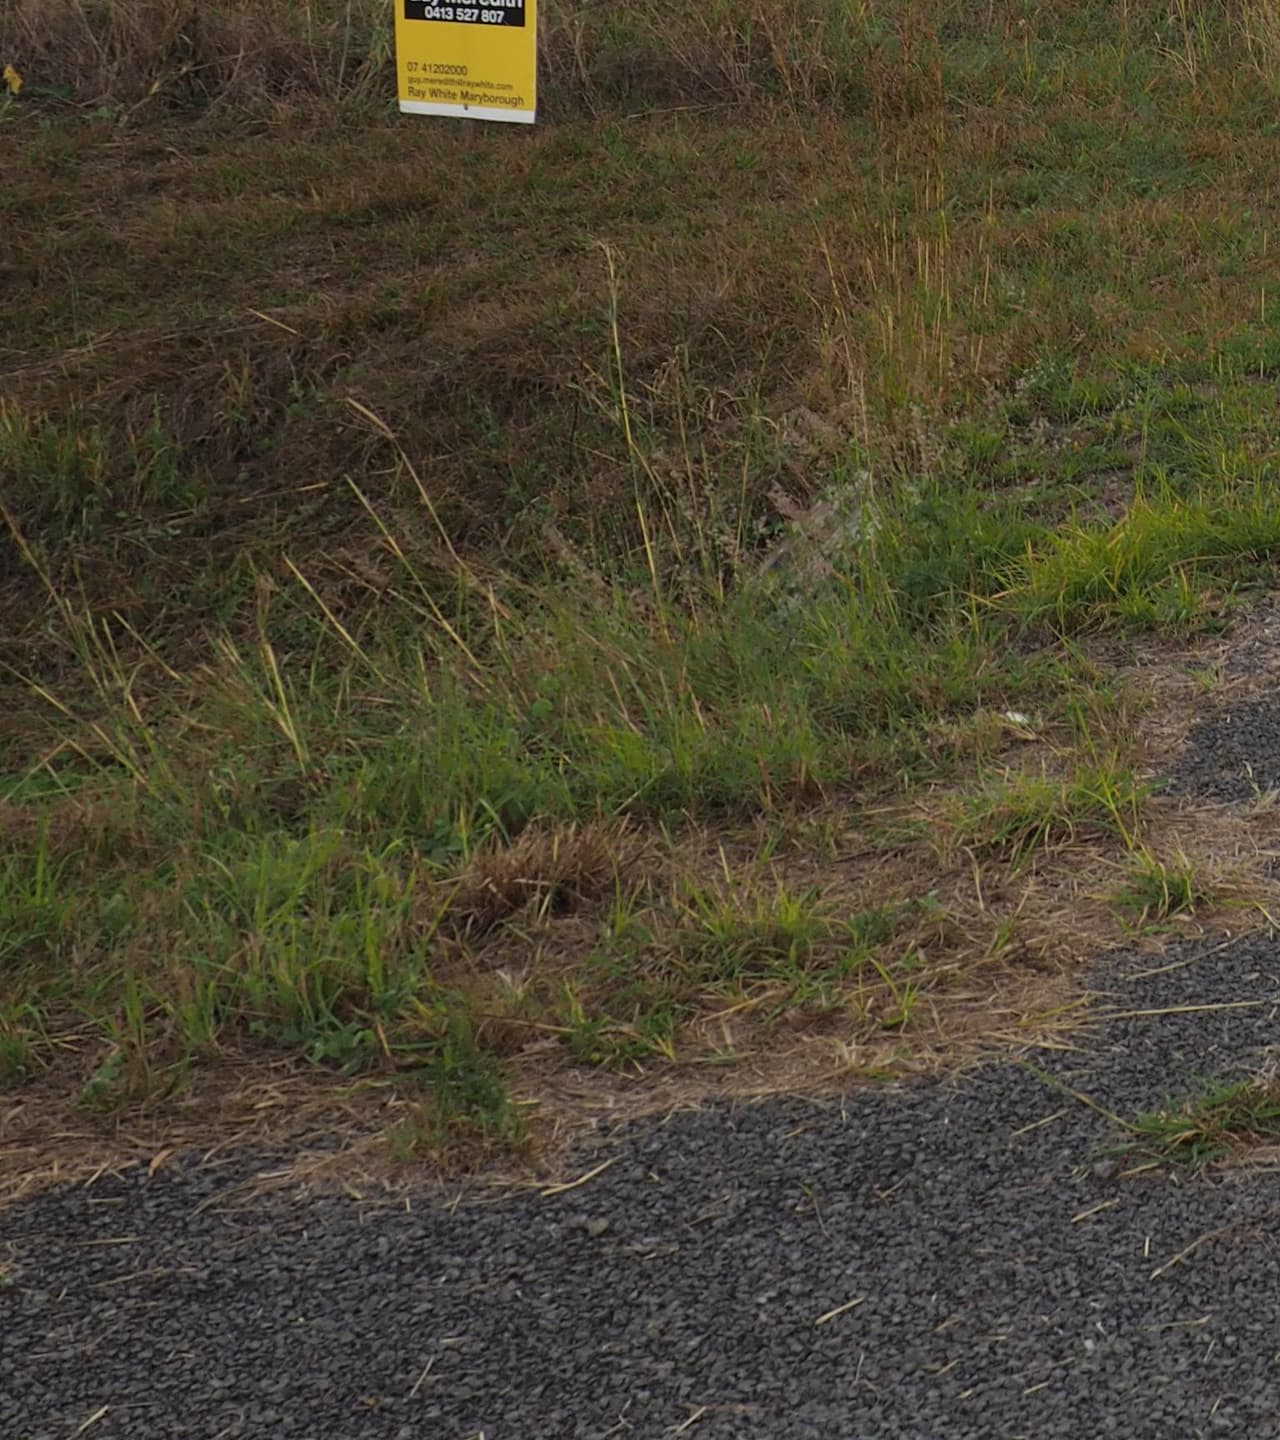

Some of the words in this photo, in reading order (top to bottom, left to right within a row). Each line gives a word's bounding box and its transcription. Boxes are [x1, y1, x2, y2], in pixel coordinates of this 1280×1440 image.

[424, 6, 454, 20] 0413
[455, 7, 479, 21] 527
[481, 9, 505, 23] 807
[408, 86, 426, 99] Ray
[428, 87, 458, 100] White
[460, 91, 524, 106] Maryborough
